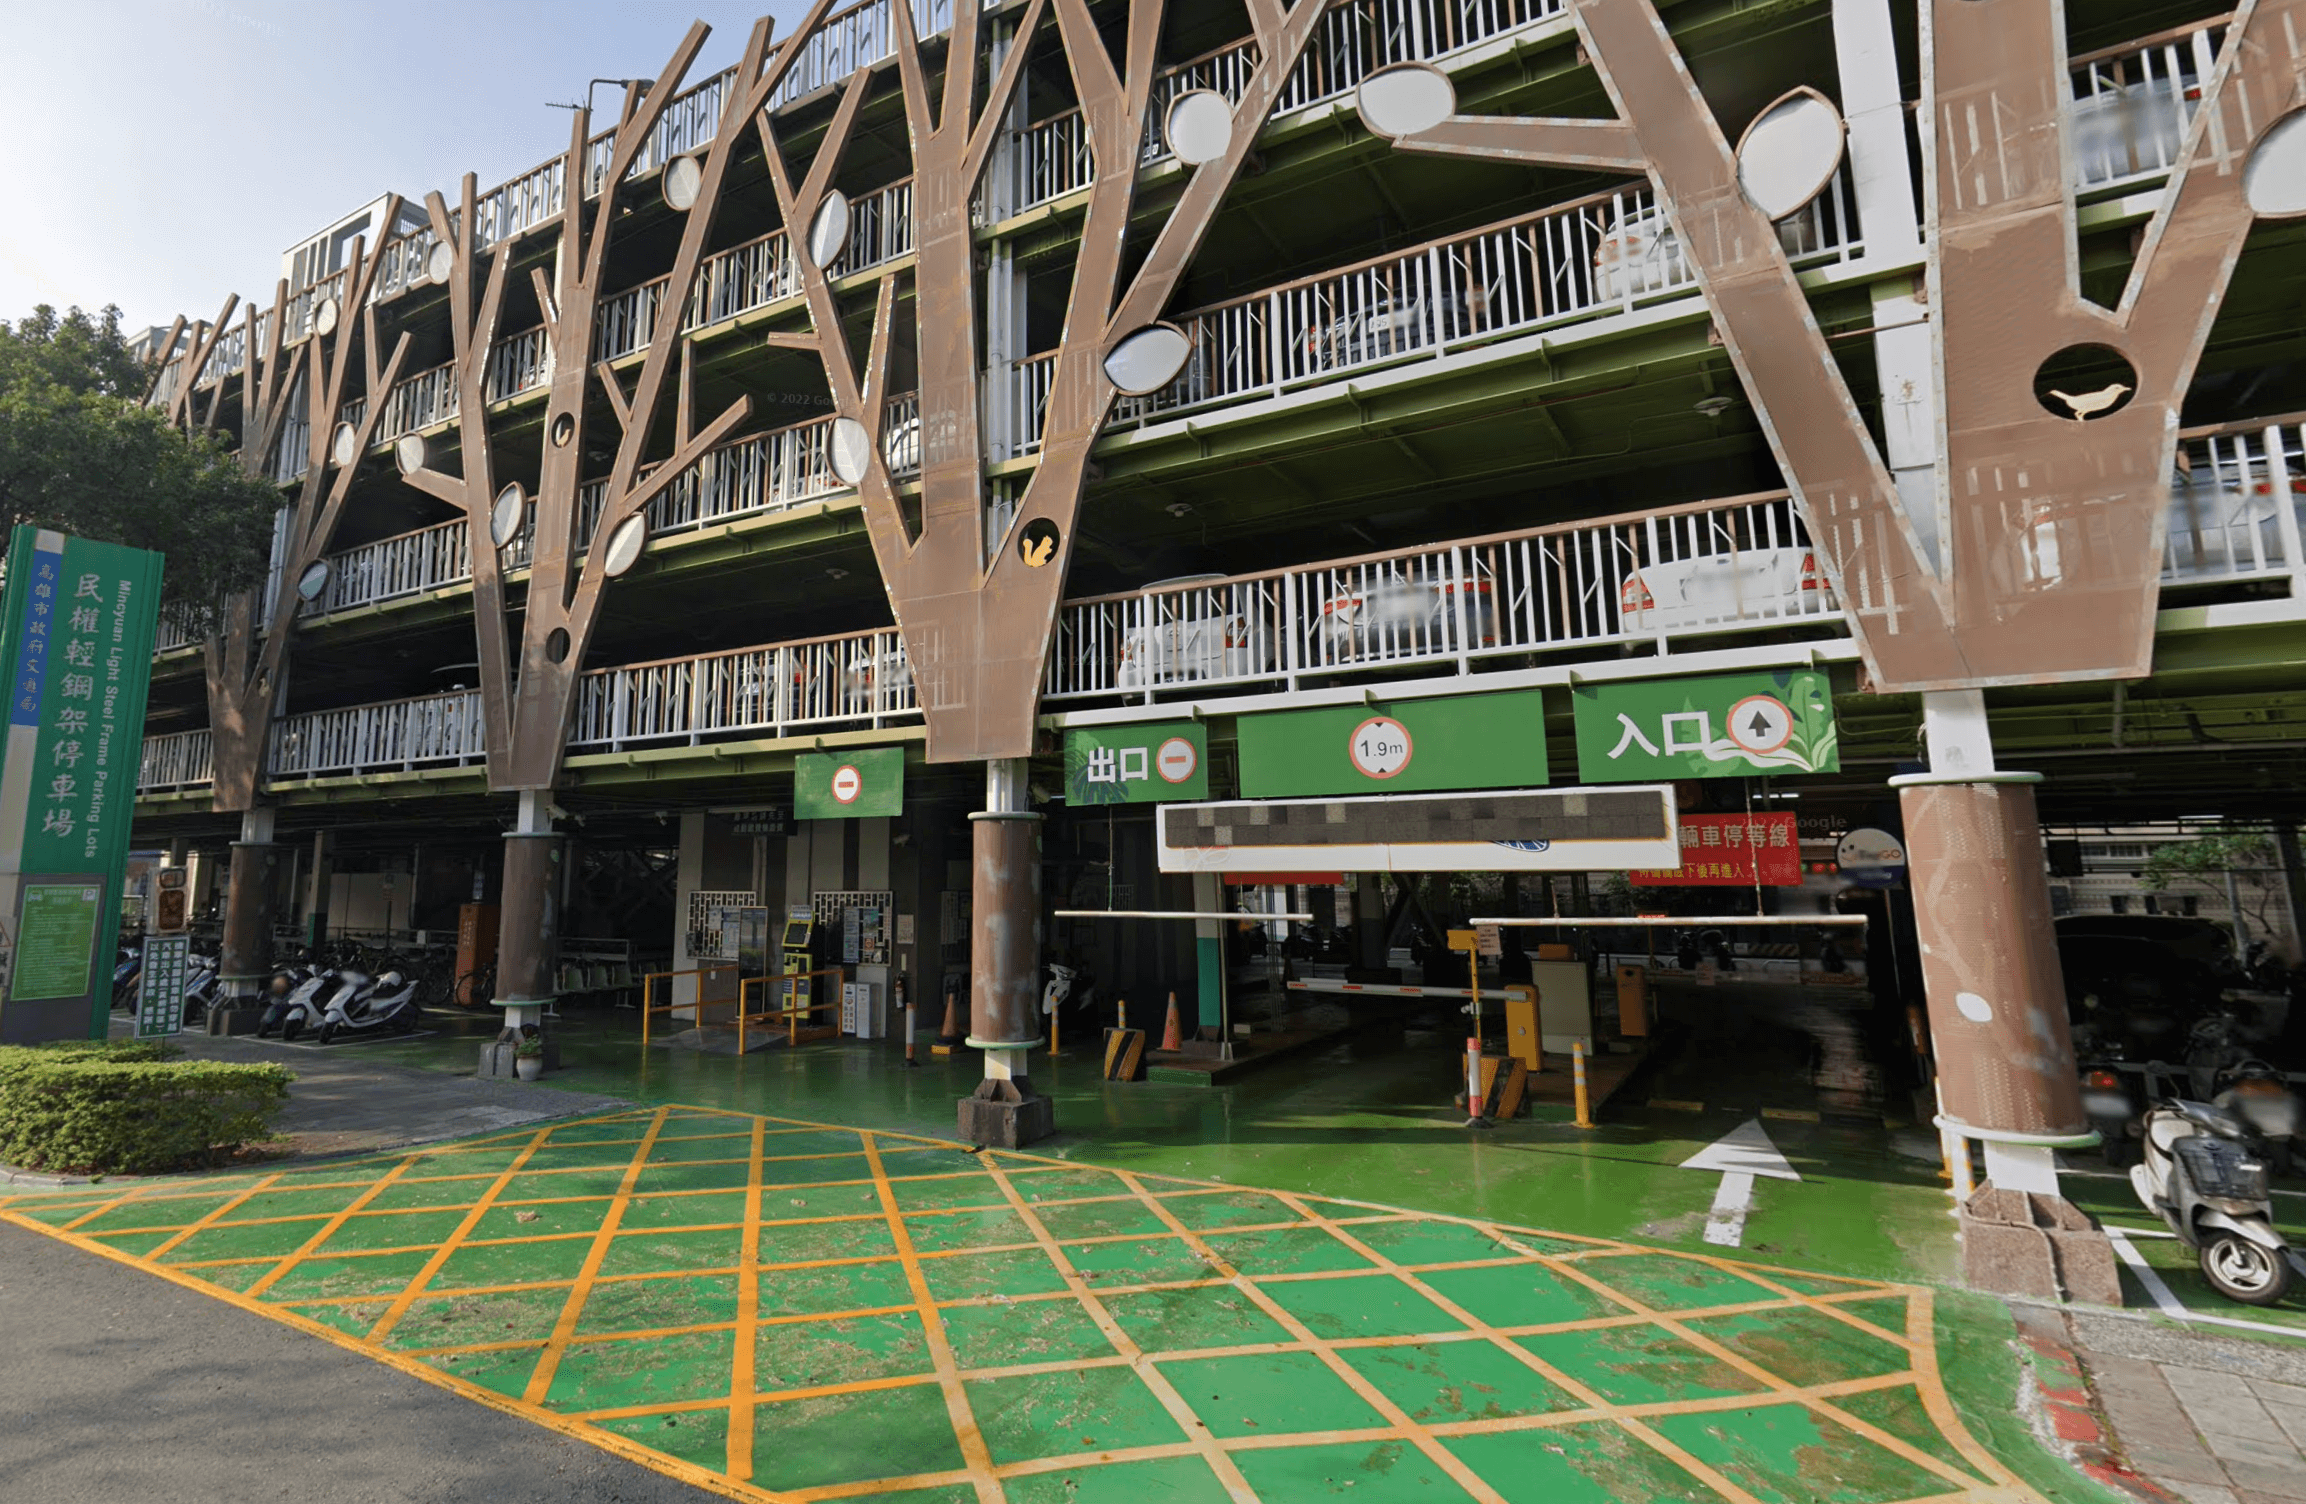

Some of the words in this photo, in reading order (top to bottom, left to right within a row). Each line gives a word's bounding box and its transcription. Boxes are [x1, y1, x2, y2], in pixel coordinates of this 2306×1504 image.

[106, 647, 124, 681] Light
[41, 573, 104, 837] 民權輕鋼架停車場
[103, 685, 119, 719] Steel
[97, 724, 115, 766] Frame
[1360, 739, 1404, 757] 1.9m
[1607, 711, 1711, 760] 入口
[1087, 745, 1149, 783] 出口
[86, 771, 108, 823] Parking
[84, 828, 100, 858] Lots
